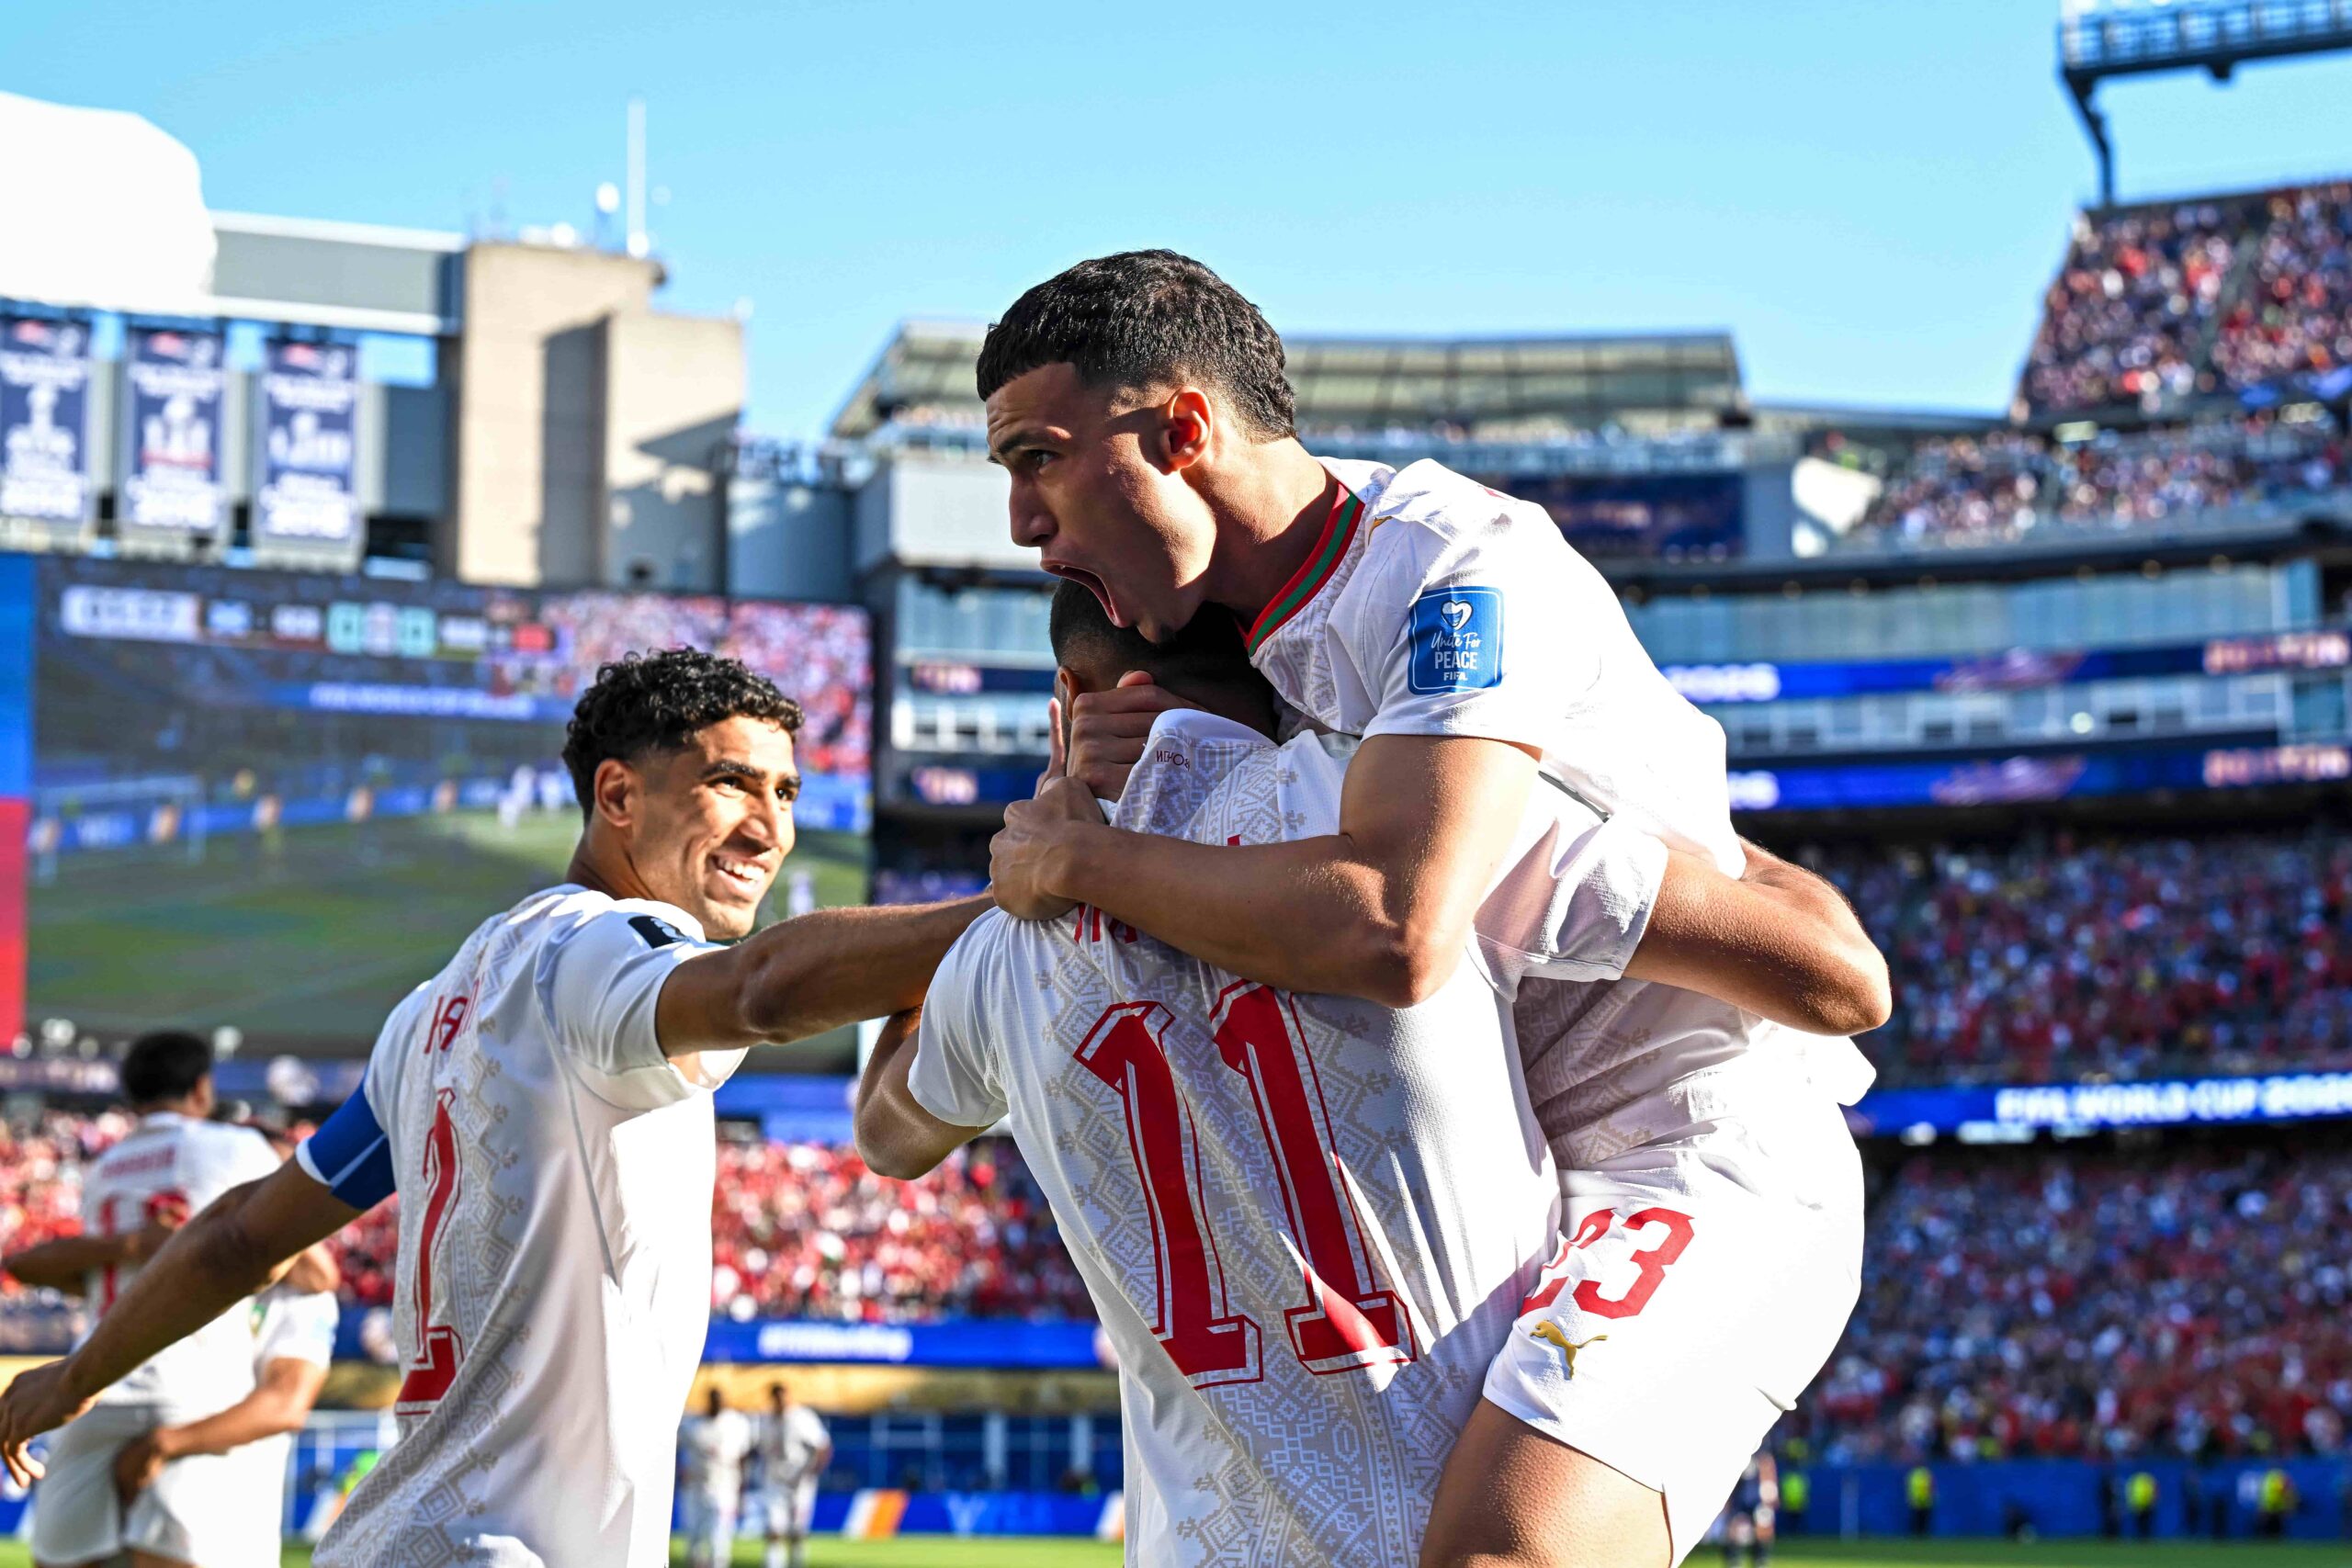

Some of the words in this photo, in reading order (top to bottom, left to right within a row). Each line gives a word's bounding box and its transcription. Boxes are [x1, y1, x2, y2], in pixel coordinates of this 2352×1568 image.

[1431, 630, 1463, 650] Unite
[1463, 632, 1483, 650] For
[1434, 651, 1478, 670] PEACE
[1443, 671, 1468, 681] FIFA
[1073, 978, 1418, 1390] 11
[1519, 1207, 1695, 1319] 23
